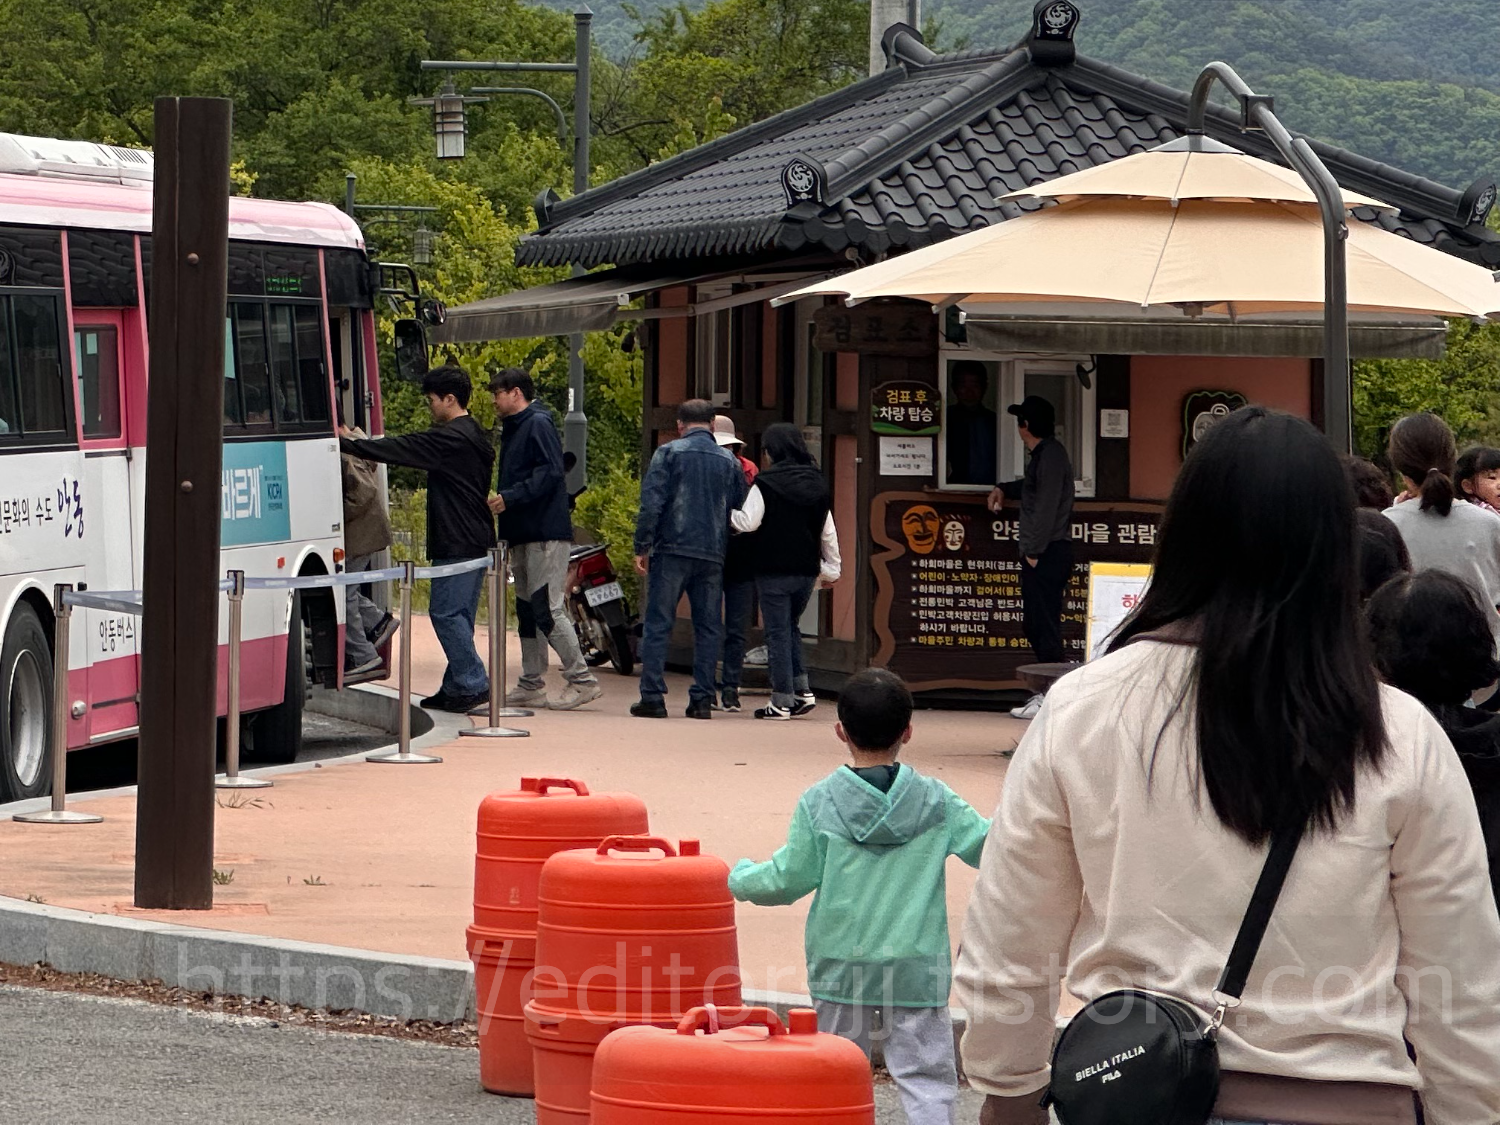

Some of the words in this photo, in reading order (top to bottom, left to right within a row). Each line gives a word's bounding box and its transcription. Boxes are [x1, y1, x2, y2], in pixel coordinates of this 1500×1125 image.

[886, 389, 912, 405] 검표
[914, 389, 928, 405] 후
[879, 406, 906, 422] 차량
[908, 406, 934, 423] 탑승
[35, 496, 54, 527] 수도
[919, 558, 963, 570] 하회마을은
[99, 615, 134, 652] 안동버스
[919, 622, 947, 633] 하시기
[1074, 1060, 1110, 1082] BIELLA
[1111, 1045, 1146, 1066] ITALIA
[1101, 1069, 1122, 1084] FILA
